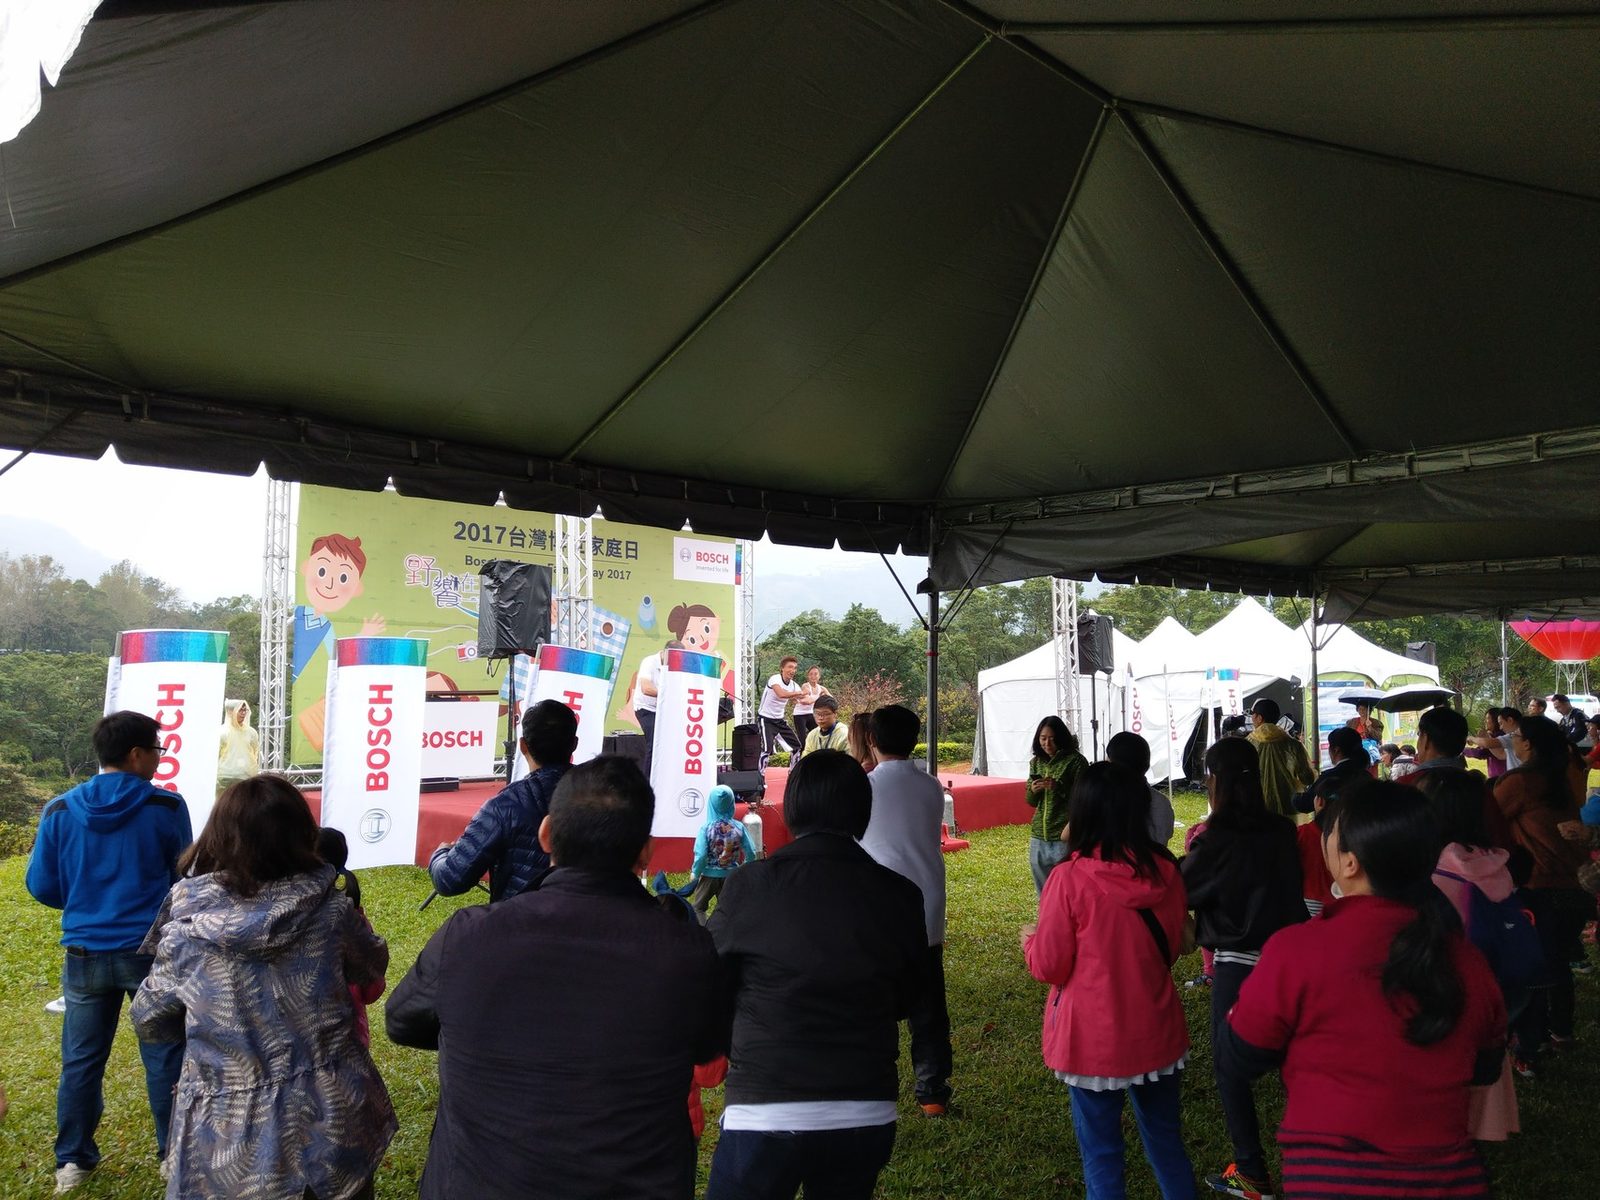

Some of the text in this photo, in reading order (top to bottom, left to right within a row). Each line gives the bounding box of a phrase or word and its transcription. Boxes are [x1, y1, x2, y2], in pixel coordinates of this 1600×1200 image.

[465, 555, 496, 567] Bos
[607, 569, 632, 580] 2017
[696, 551, 729, 564] BOSCH
[366, 684, 393, 792] BOSCH
[684, 688, 704, 775] BOSCH
